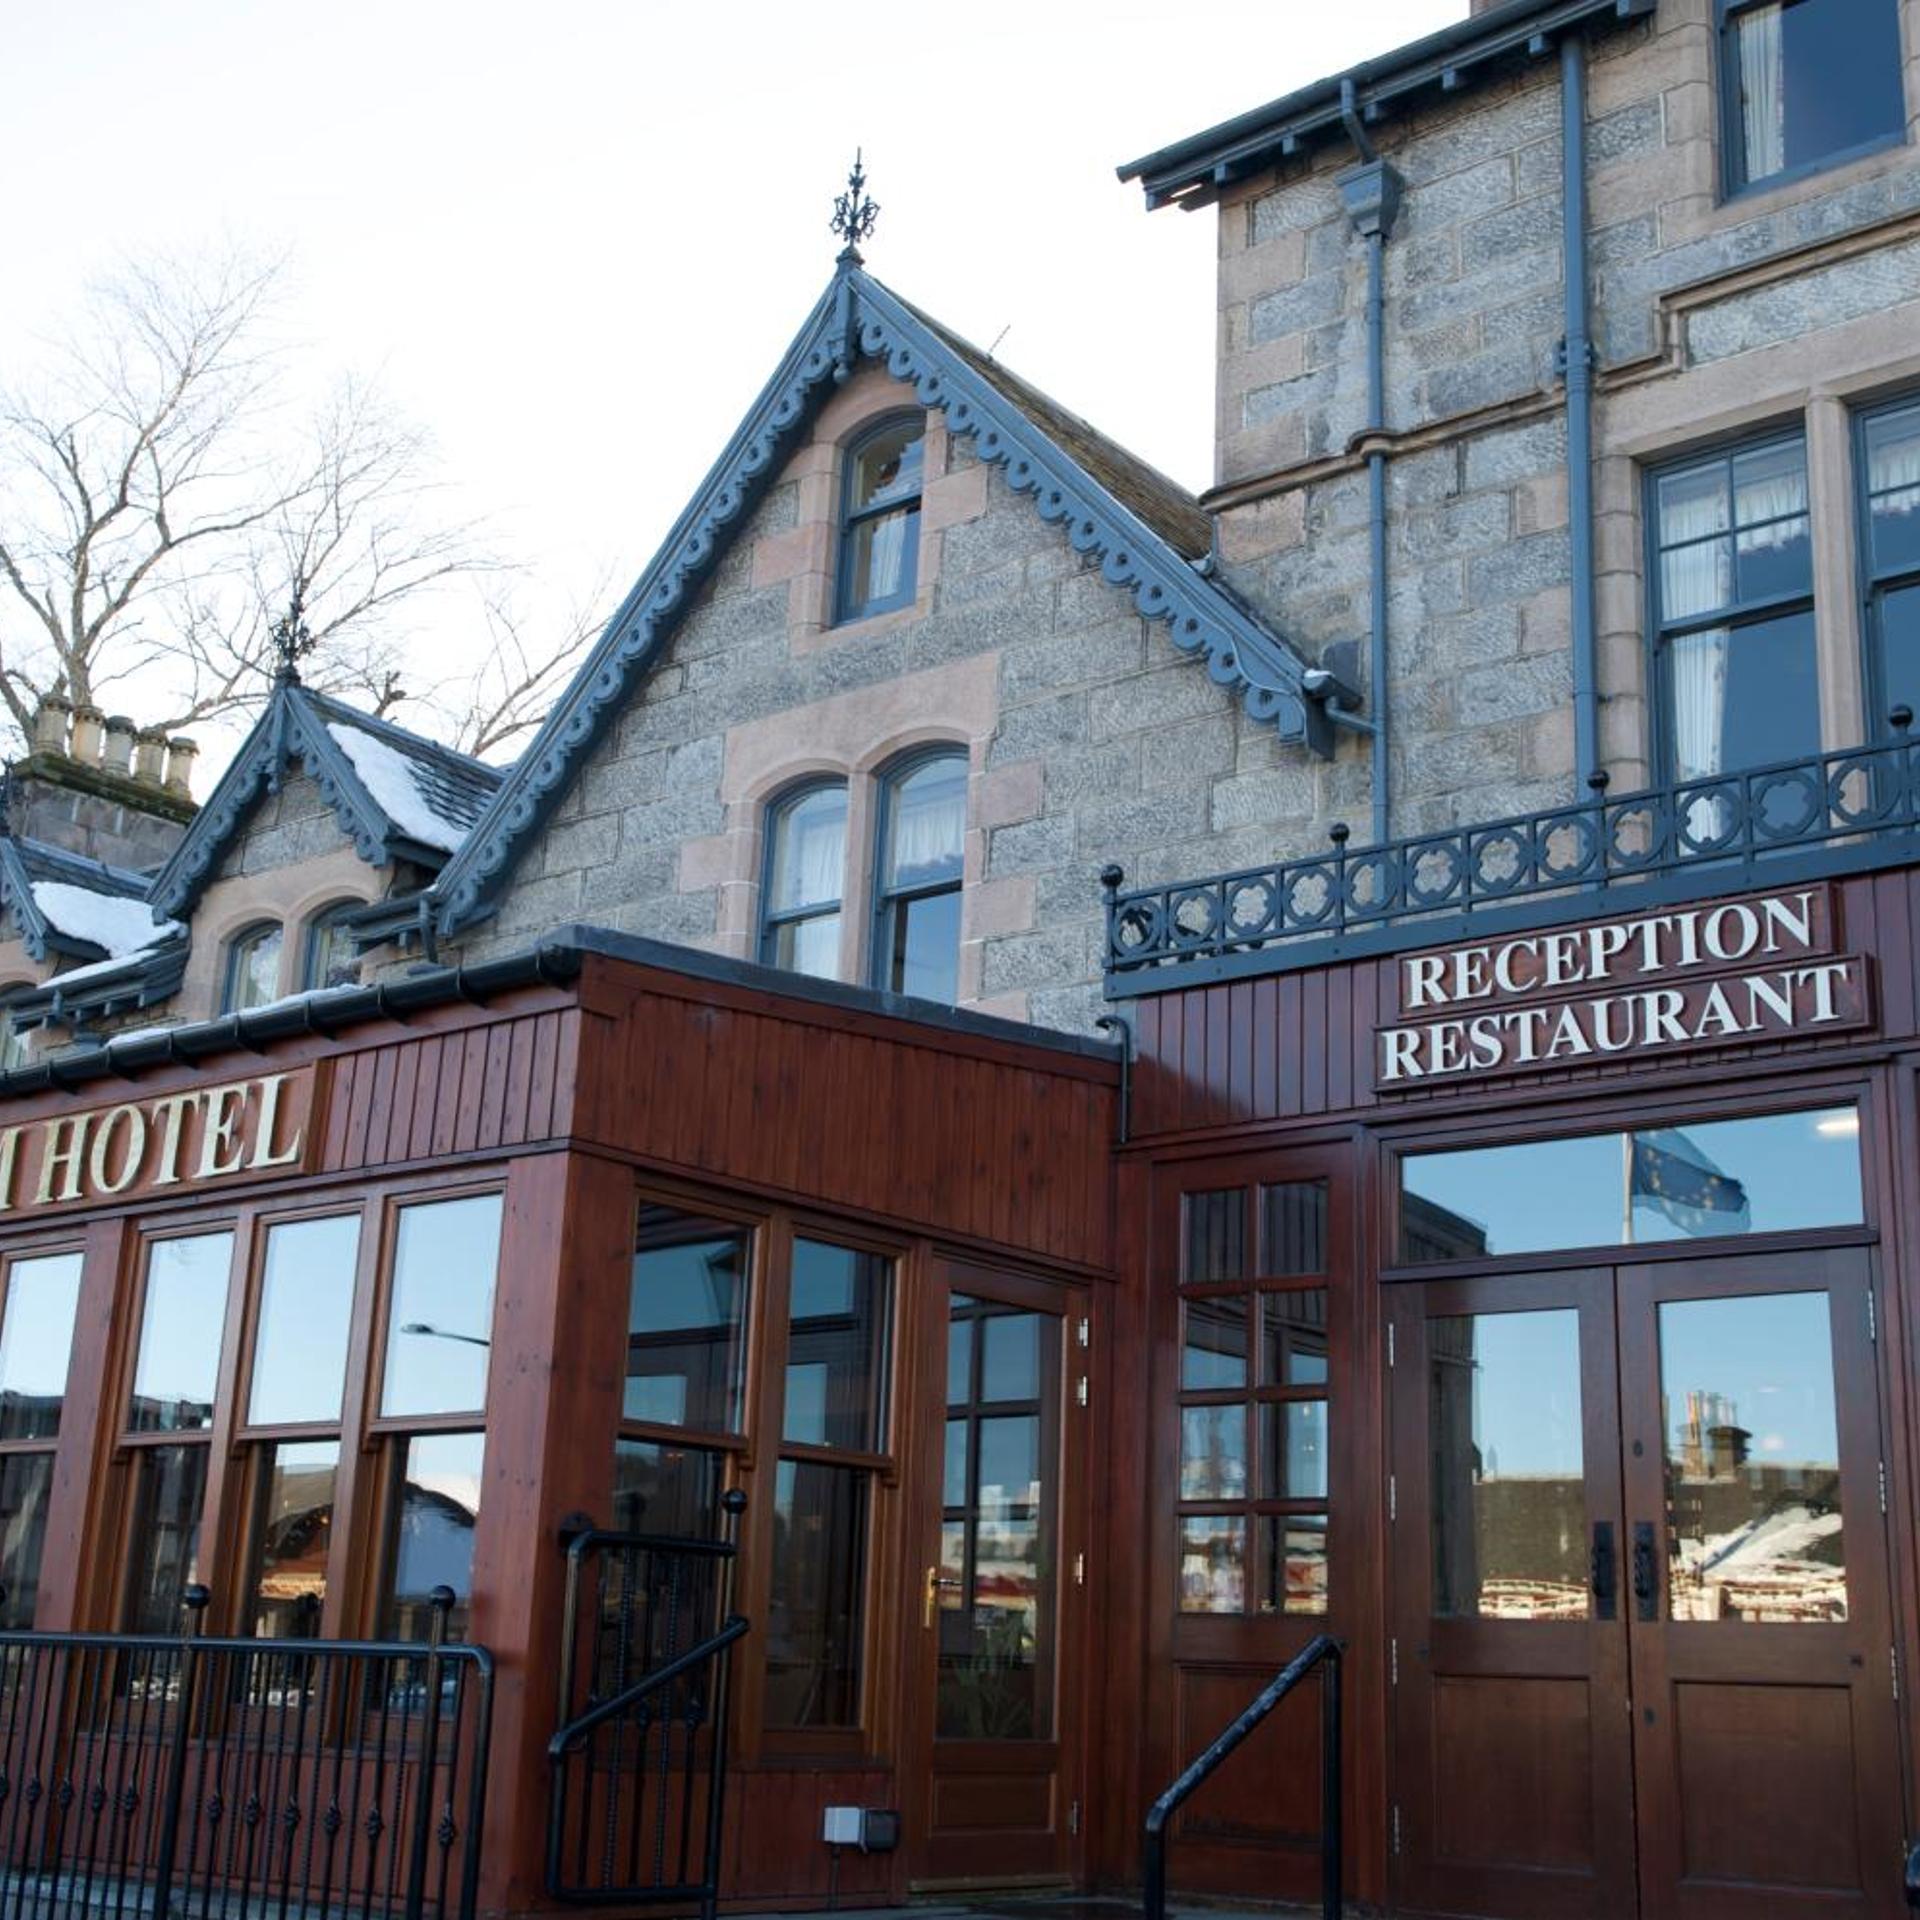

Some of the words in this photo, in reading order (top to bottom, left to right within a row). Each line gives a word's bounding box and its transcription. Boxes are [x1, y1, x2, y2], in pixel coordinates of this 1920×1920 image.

[1406, 893, 1814, 1008] RECEPTION
[1379, 963, 1848, 1081] RESTAURANT
[34, 1074, 301, 1205] HOTEL
